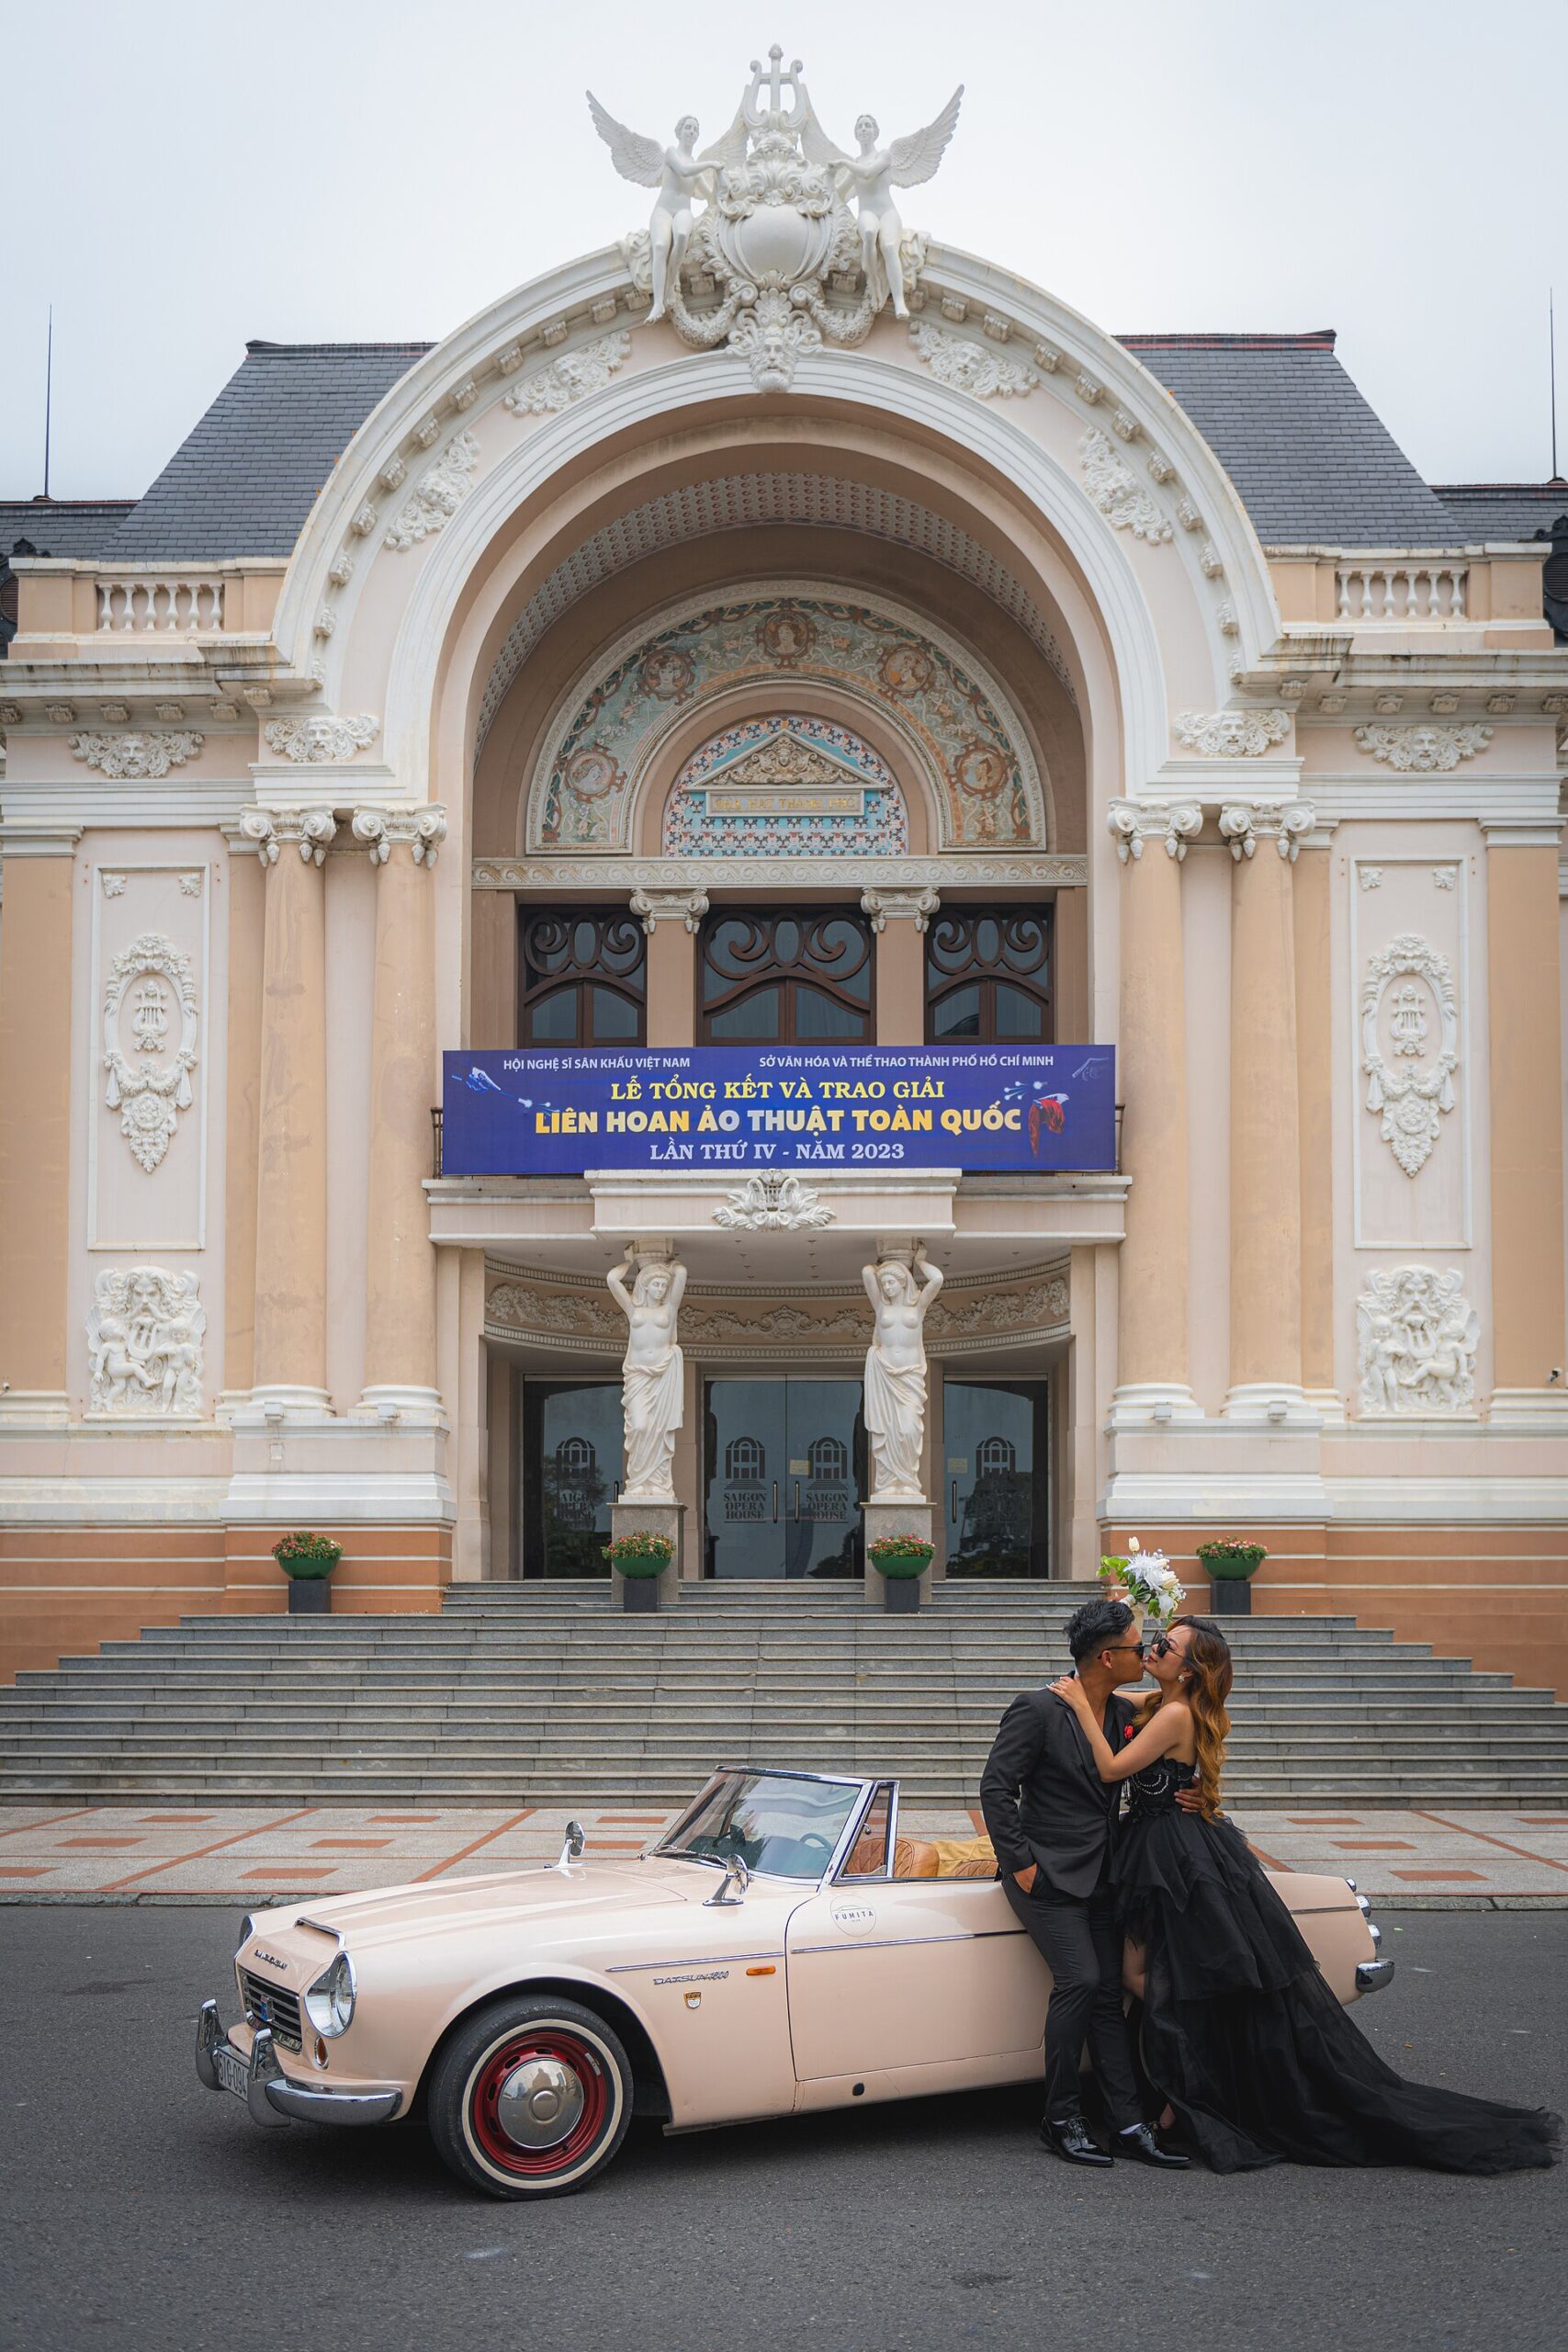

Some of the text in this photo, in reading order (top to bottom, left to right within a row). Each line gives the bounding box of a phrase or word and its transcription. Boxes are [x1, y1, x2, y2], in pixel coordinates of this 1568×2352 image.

[503, 1056, 691, 1072] HỘI NGHỆ SĨ SÂN KHẤU VIỆT NAM
[759, 1054, 776, 1068] SỞ
[777, 1055, 802, 1068] VĂN
[805, 1055, 830, 1068] HÓA
[832, 1055, 848, 1068] VÀ
[874, 1057, 907, 1068] THAO
[908, 1055, 950, 1067] THÀNH
[952, 1053, 977, 1067] PHỐ
[979, 1053, 997, 1067] HỒ
[999, 1056, 1020, 1067] CHÍ
[1021, 1056, 1054, 1066] MINH
[611, 1073, 945, 1100] LỄ TỔNG KẾT VÀ TRAO GIẢI
[536, 1100, 1021, 1136] LIÊN HOAN ẢO THUẬT TOÀN QUỐC
[649, 1136, 694, 1160] LẦN
[700, 1139, 748, 1159] THỨ
[753, 1144, 777, 1159] IV
[795, 1140, 845, 1159] NĂM
[851, 1143, 905, 1159] 2023
[724, 1493, 767, 1502] SAIGON
[806, 1493, 849, 1502] SAIGON
[725, 1502, 765, 1510] OPERA
[808, 1502, 848, 1510] OPERA
[726, 1510, 764, 1520] HOUSE
[835, 1910, 874, 1920] FUMITA
